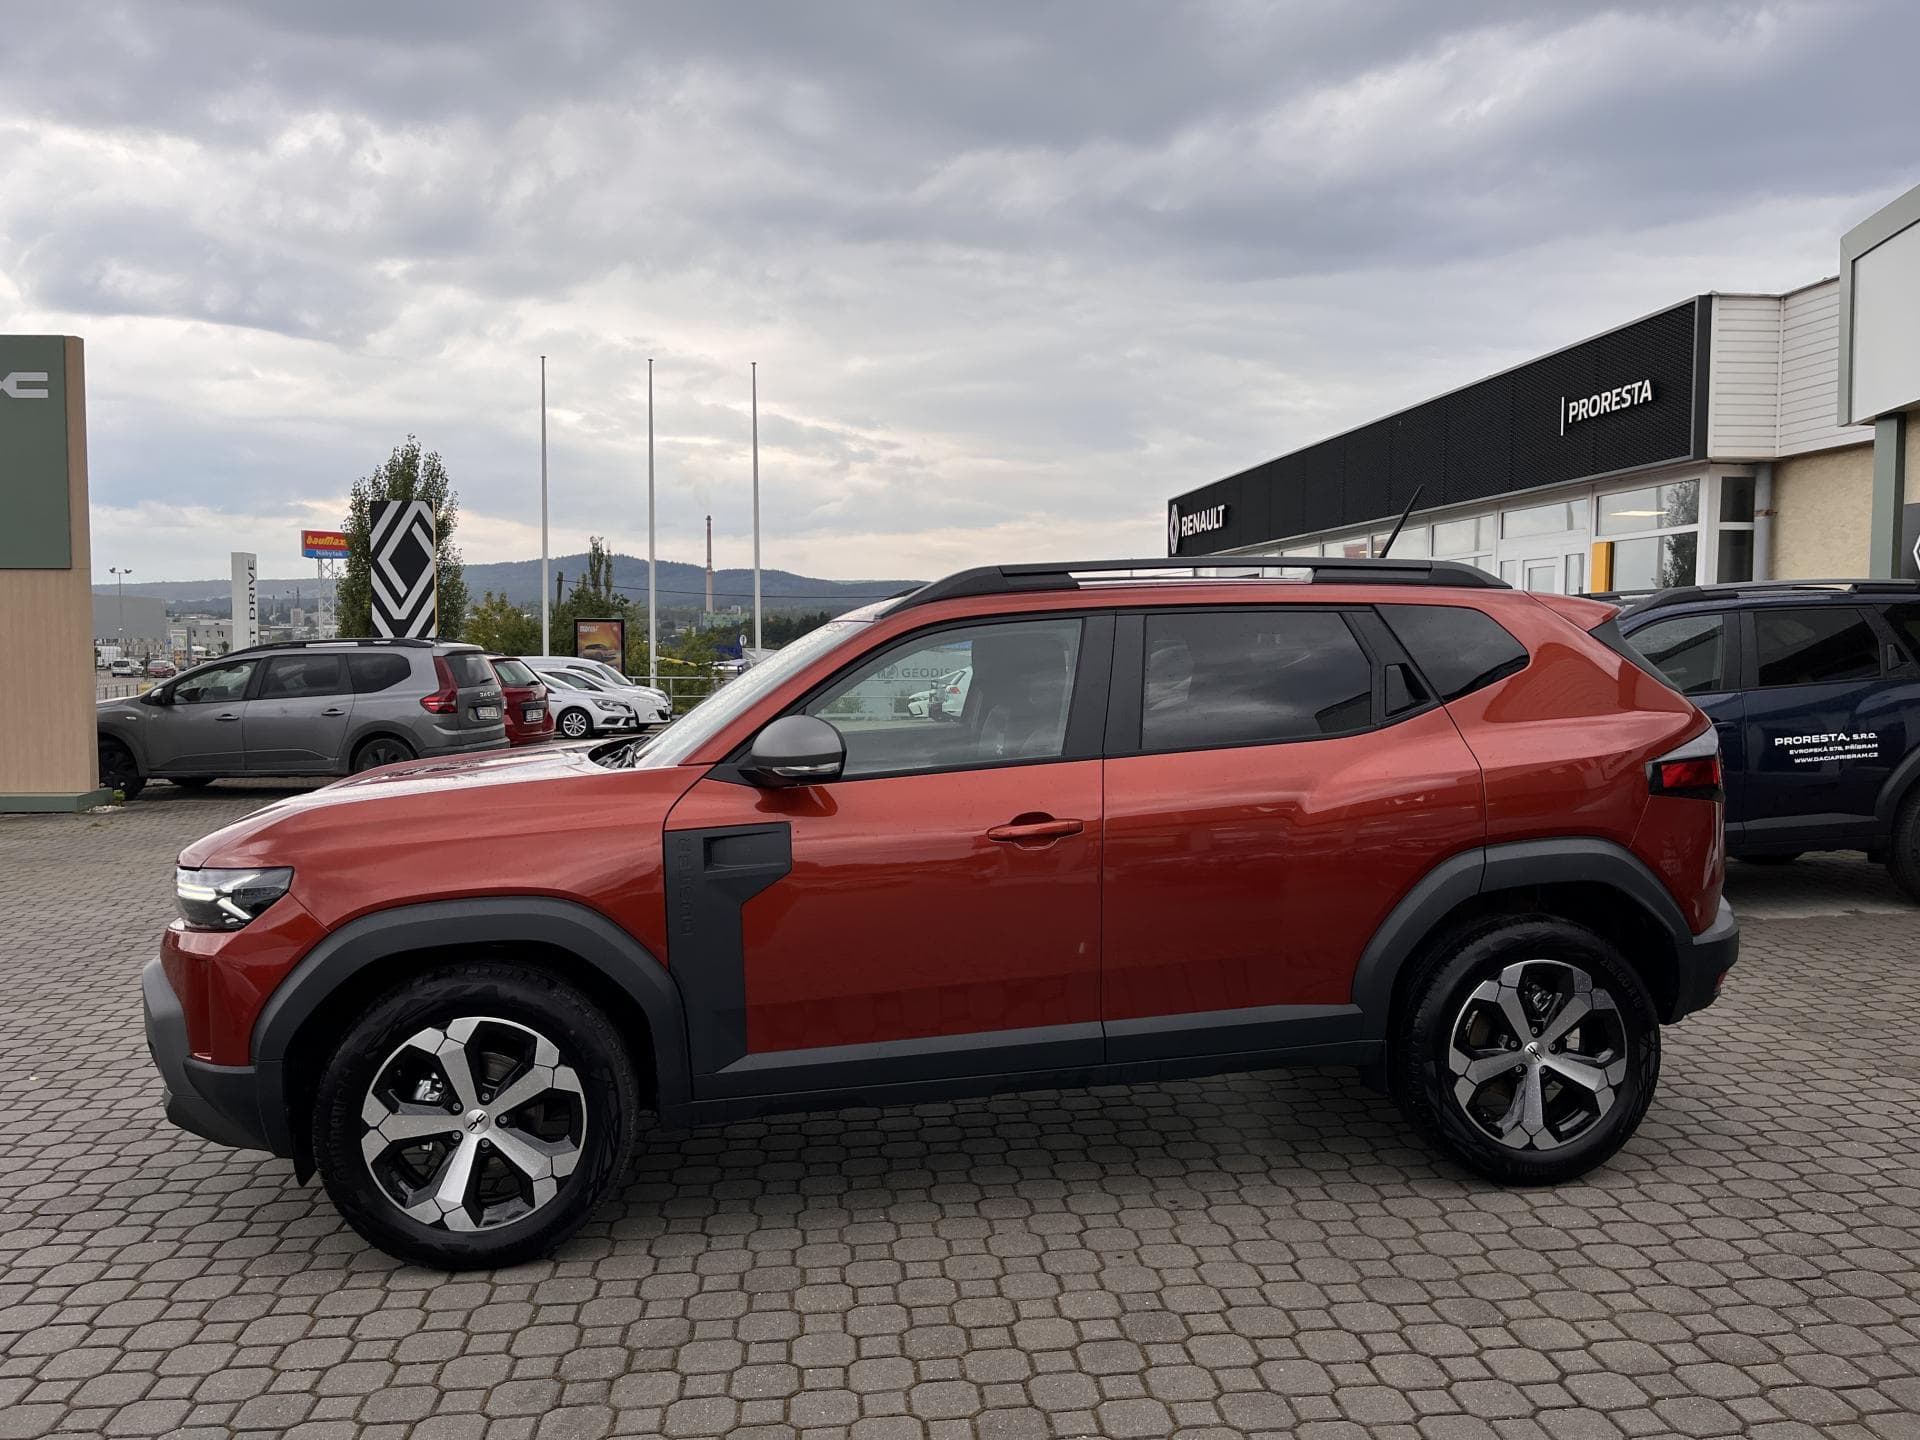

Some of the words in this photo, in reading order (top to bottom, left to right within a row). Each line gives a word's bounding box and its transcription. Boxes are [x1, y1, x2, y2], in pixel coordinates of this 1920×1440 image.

[1568, 379, 1652, 424] PRORESTA
[1181, 504, 1225, 537] RENAULT
[248, 559, 256, 621] DRIVE
[1774, 733, 1850, 746] PRORESTA,
[1852, 732, 1878, 740] S.R.O.
